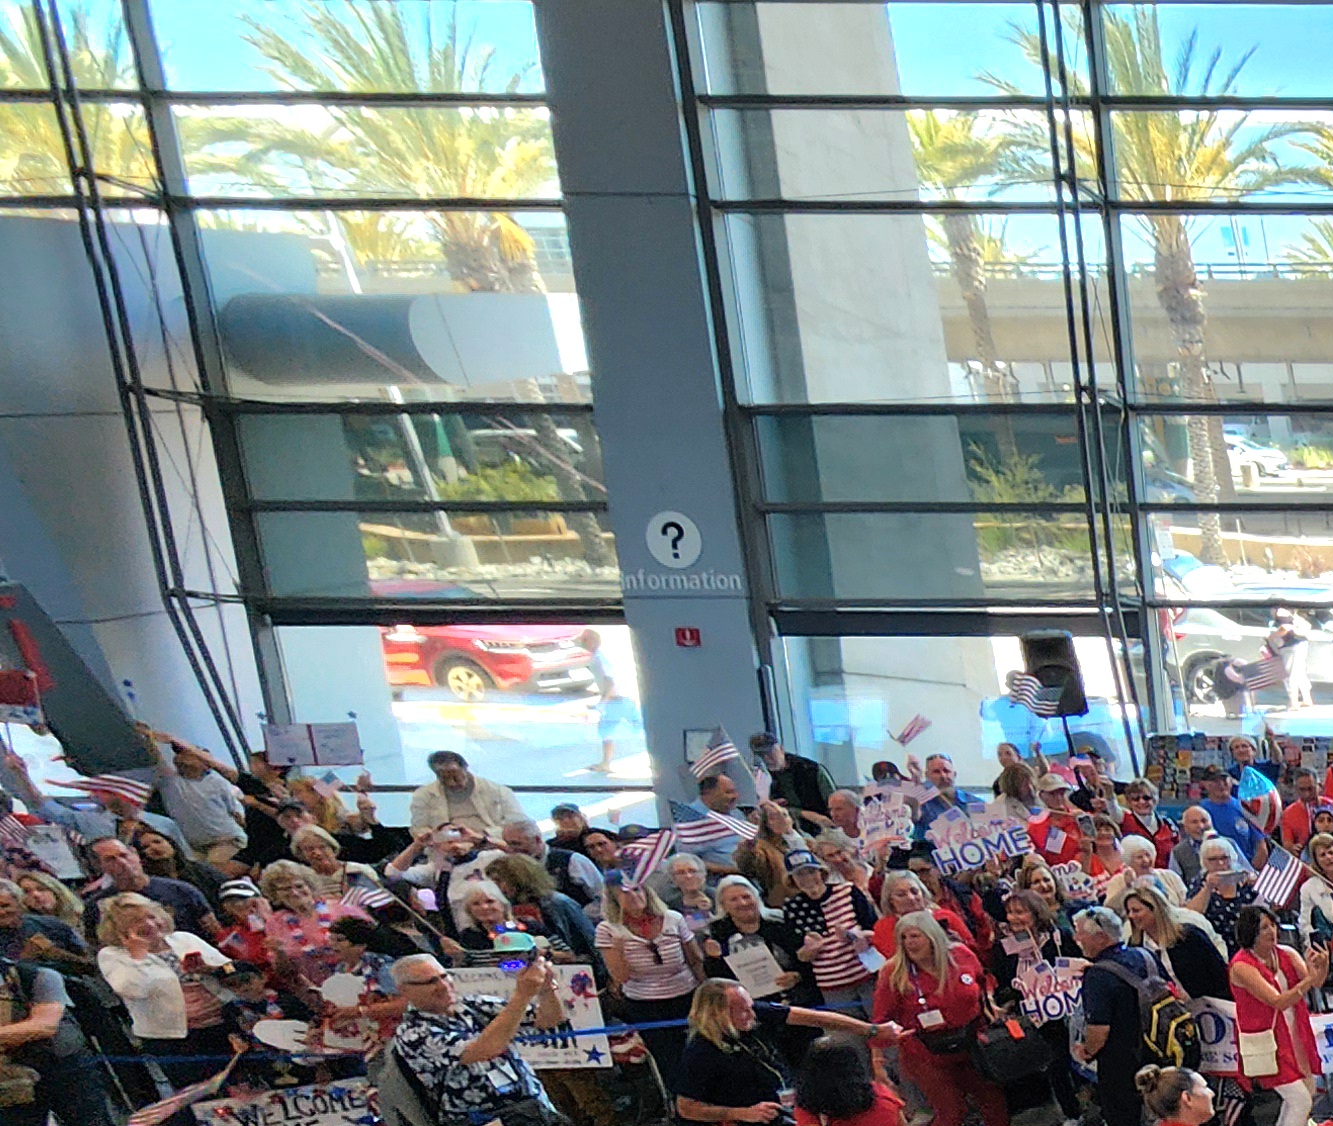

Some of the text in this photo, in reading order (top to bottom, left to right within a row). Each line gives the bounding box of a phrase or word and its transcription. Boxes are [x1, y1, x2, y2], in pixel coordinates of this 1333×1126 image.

[933, 825, 1033, 876] HOME
[1013, 974, 1083, 1001] Welcom
[1021, 988, 1084, 1021] HOM
